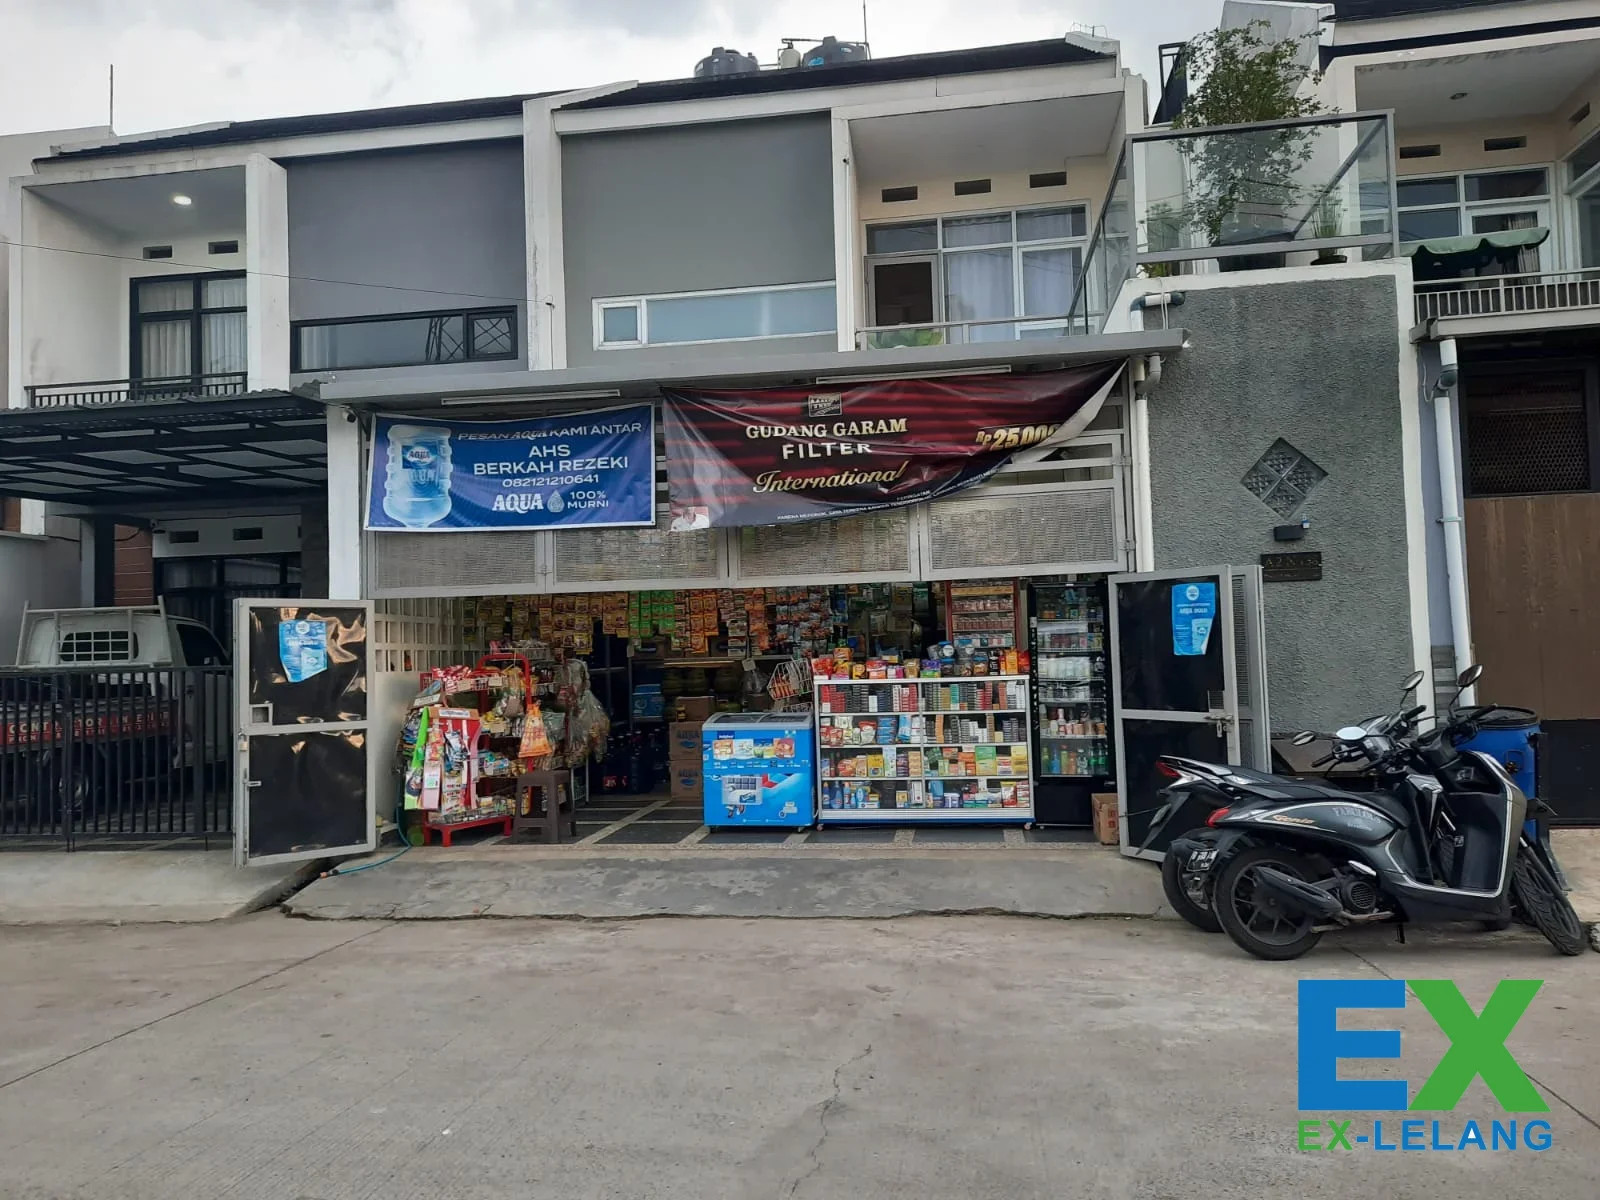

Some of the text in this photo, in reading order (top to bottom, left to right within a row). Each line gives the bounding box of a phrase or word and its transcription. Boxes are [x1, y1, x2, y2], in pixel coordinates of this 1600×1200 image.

[458, 423, 642, 441] PESAN AQUA KAMI ANTAR
[746, 418, 908, 439] GUDANG GARAM
[529, 445, 571, 458] AHS
[782, 442, 873, 460] FILTER
[473, 455, 629, 476] BERKAH REZEKI
[502, 474, 599, 488] 082121210641
[753, 461, 910, 493] International
[492, 493, 544, 514] AQUA
[570, 490, 607, 500] 100%
[567, 500, 609, 509] MURNI
